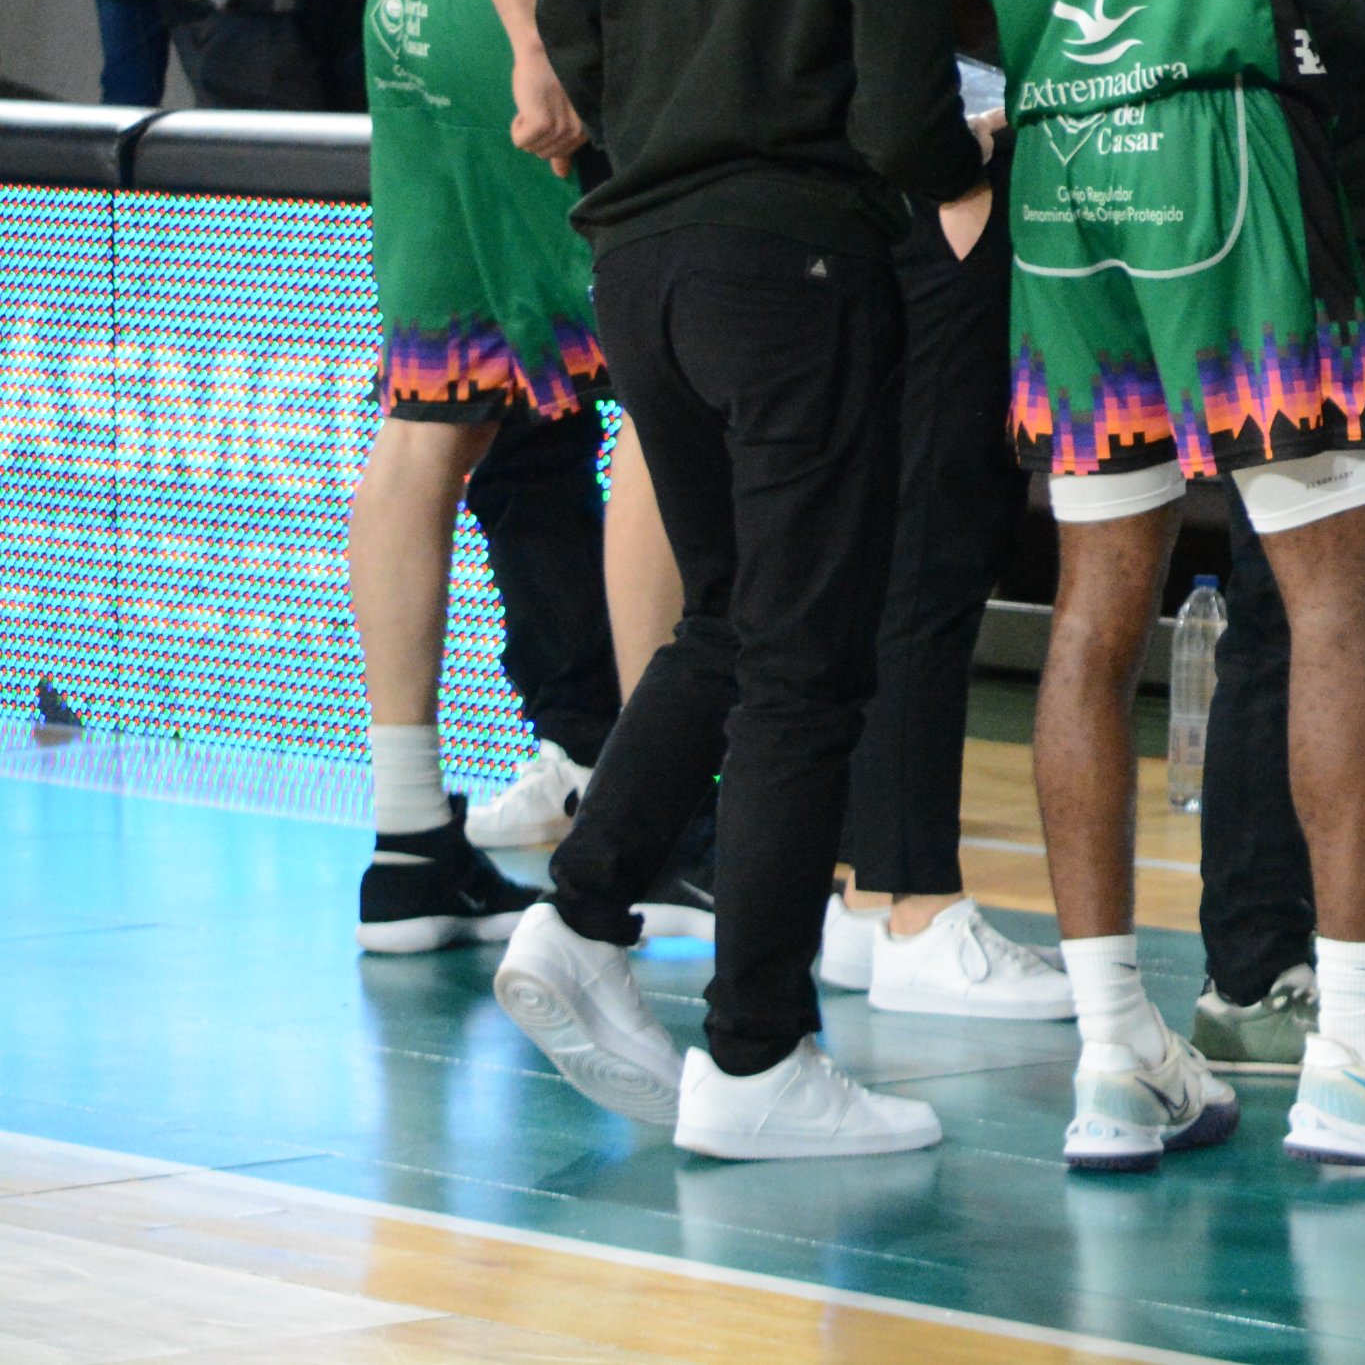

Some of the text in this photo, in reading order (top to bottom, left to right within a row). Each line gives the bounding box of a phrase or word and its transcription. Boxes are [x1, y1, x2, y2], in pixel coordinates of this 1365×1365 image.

[1019, 62, 1189, 111] Extremadura
[1114, 101, 1147, 127] del
[1097, 128, 1165, 156] Casar
[1127, 205, 1185, 226] Protegida
